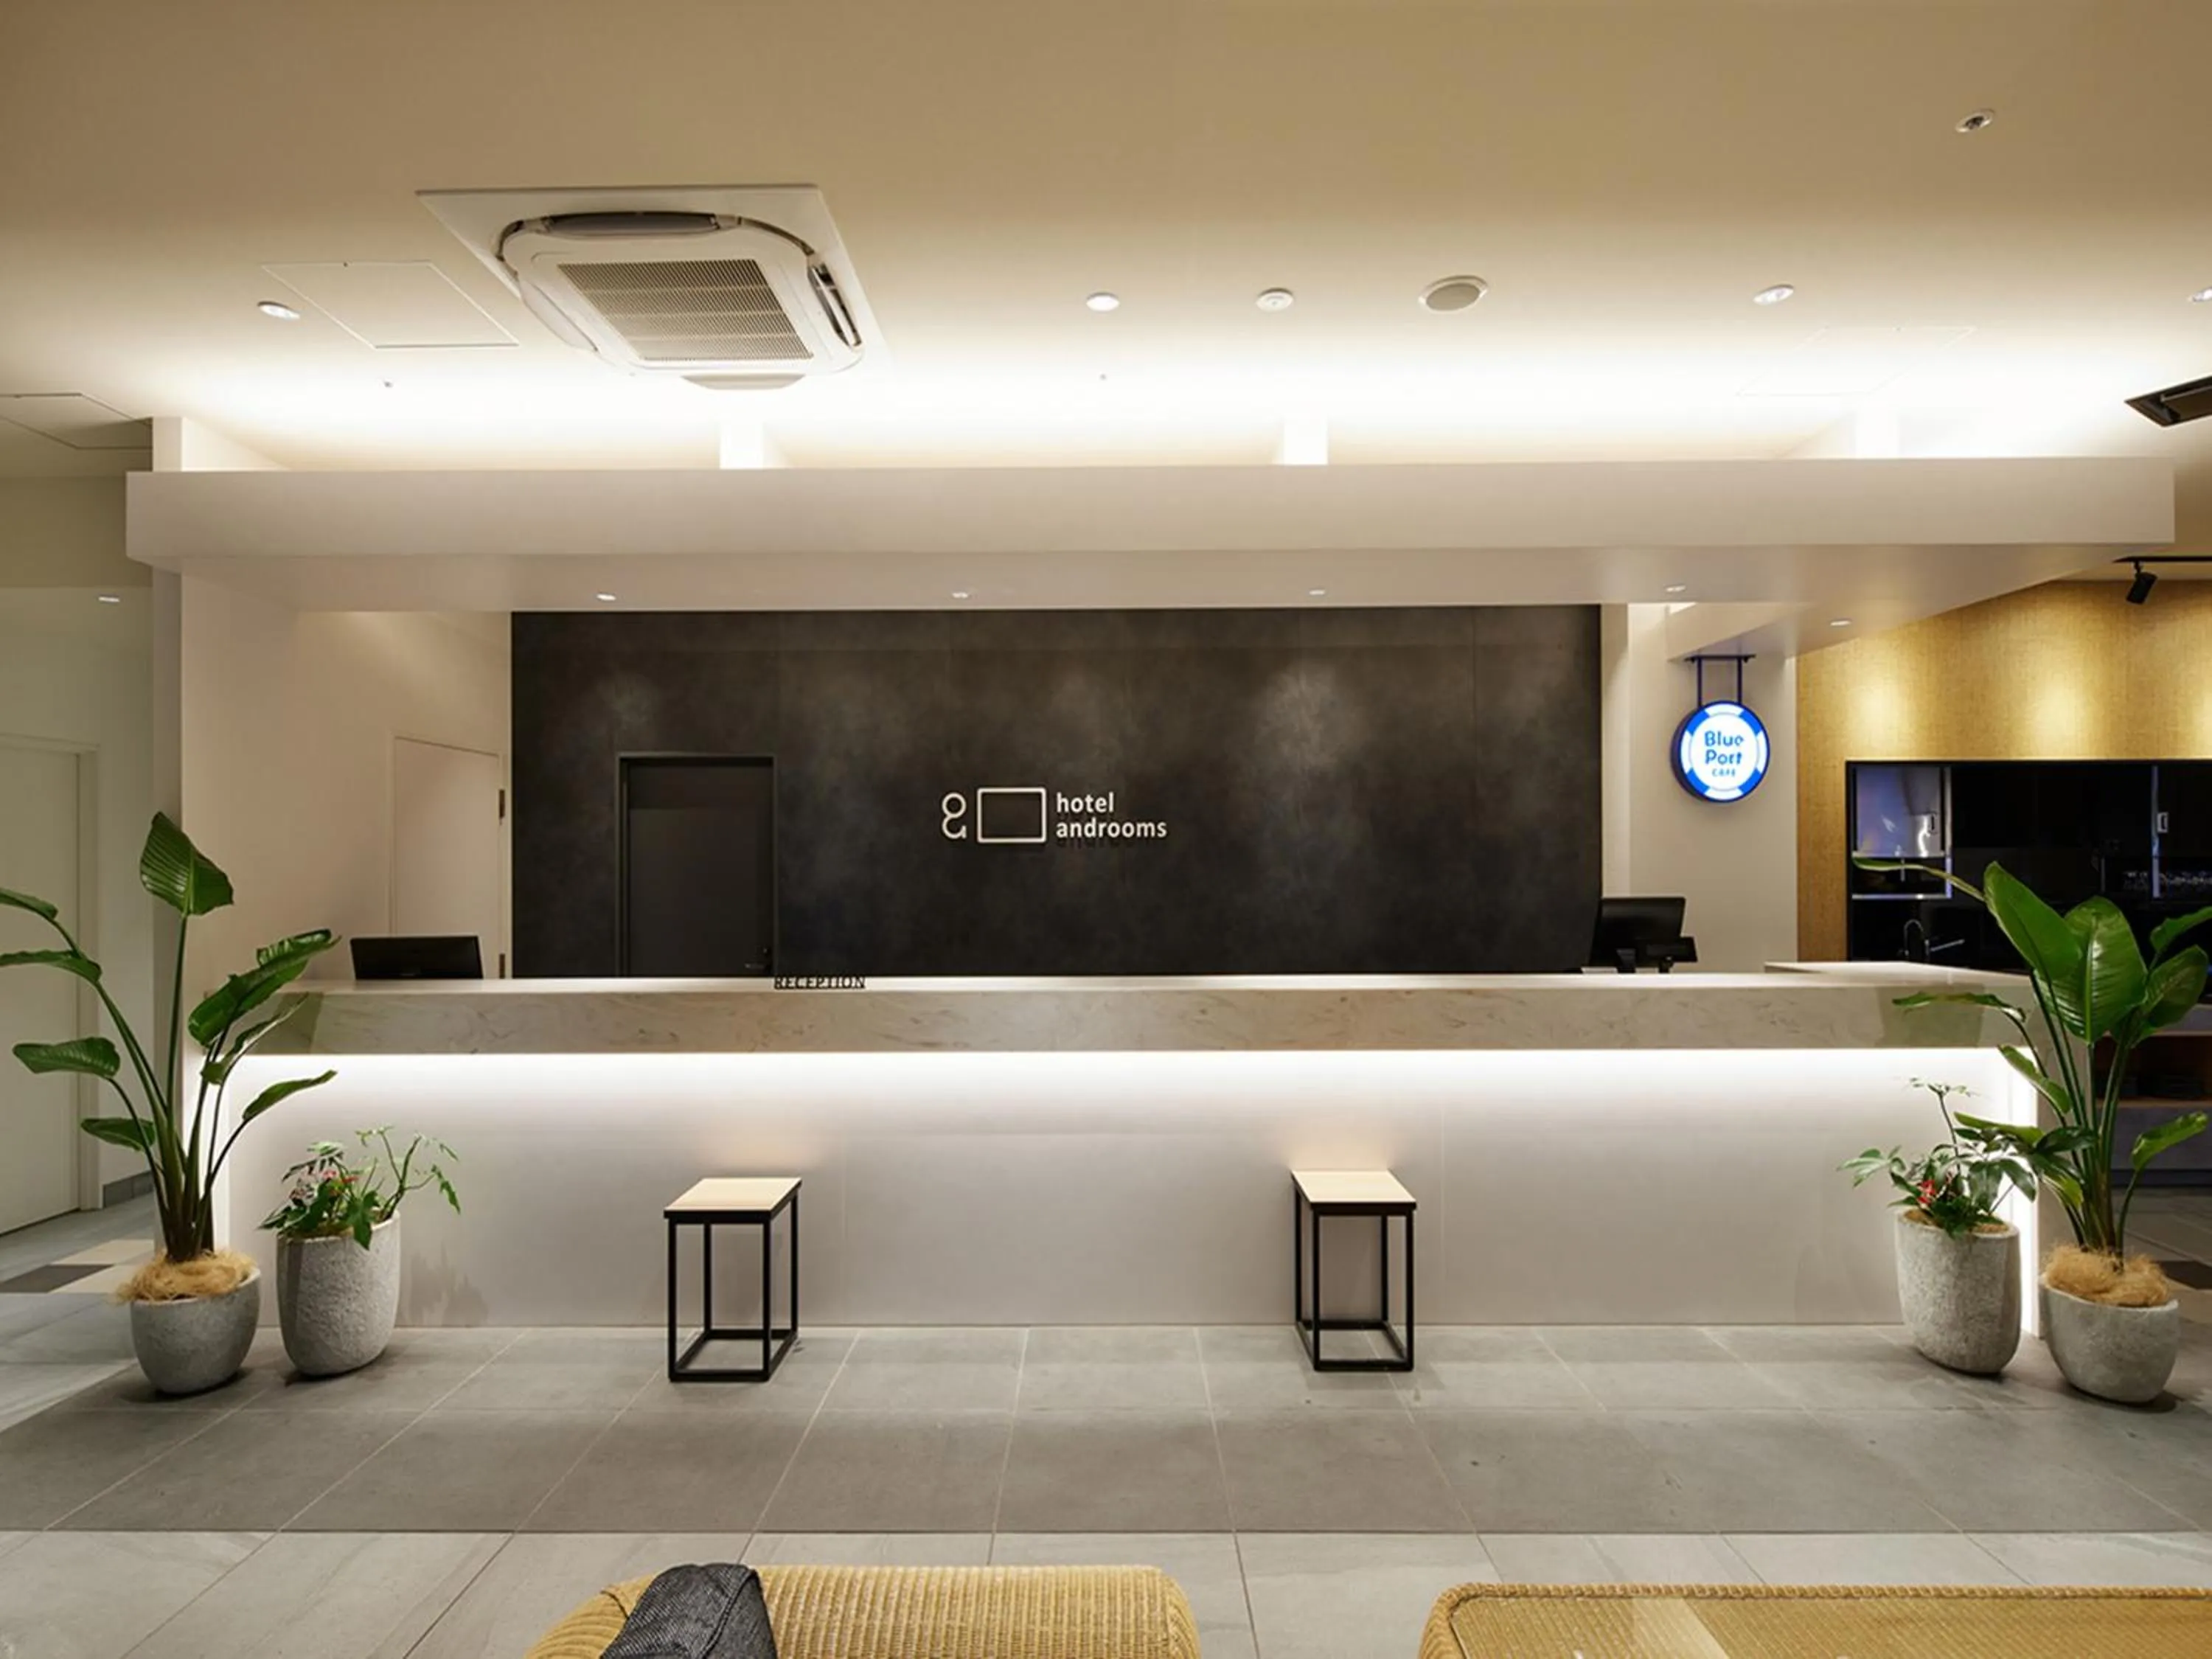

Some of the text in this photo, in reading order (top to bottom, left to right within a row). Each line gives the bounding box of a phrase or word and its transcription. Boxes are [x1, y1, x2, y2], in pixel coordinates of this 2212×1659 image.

[1705, 731, 1744, 746] Blue
[1705, 749, 1742, 765] Port
[1056, 792, 1114, 813] hotel
[1056, 817, 1167, 838] androoms
[774, 975, 866, 989] RECEPTION
